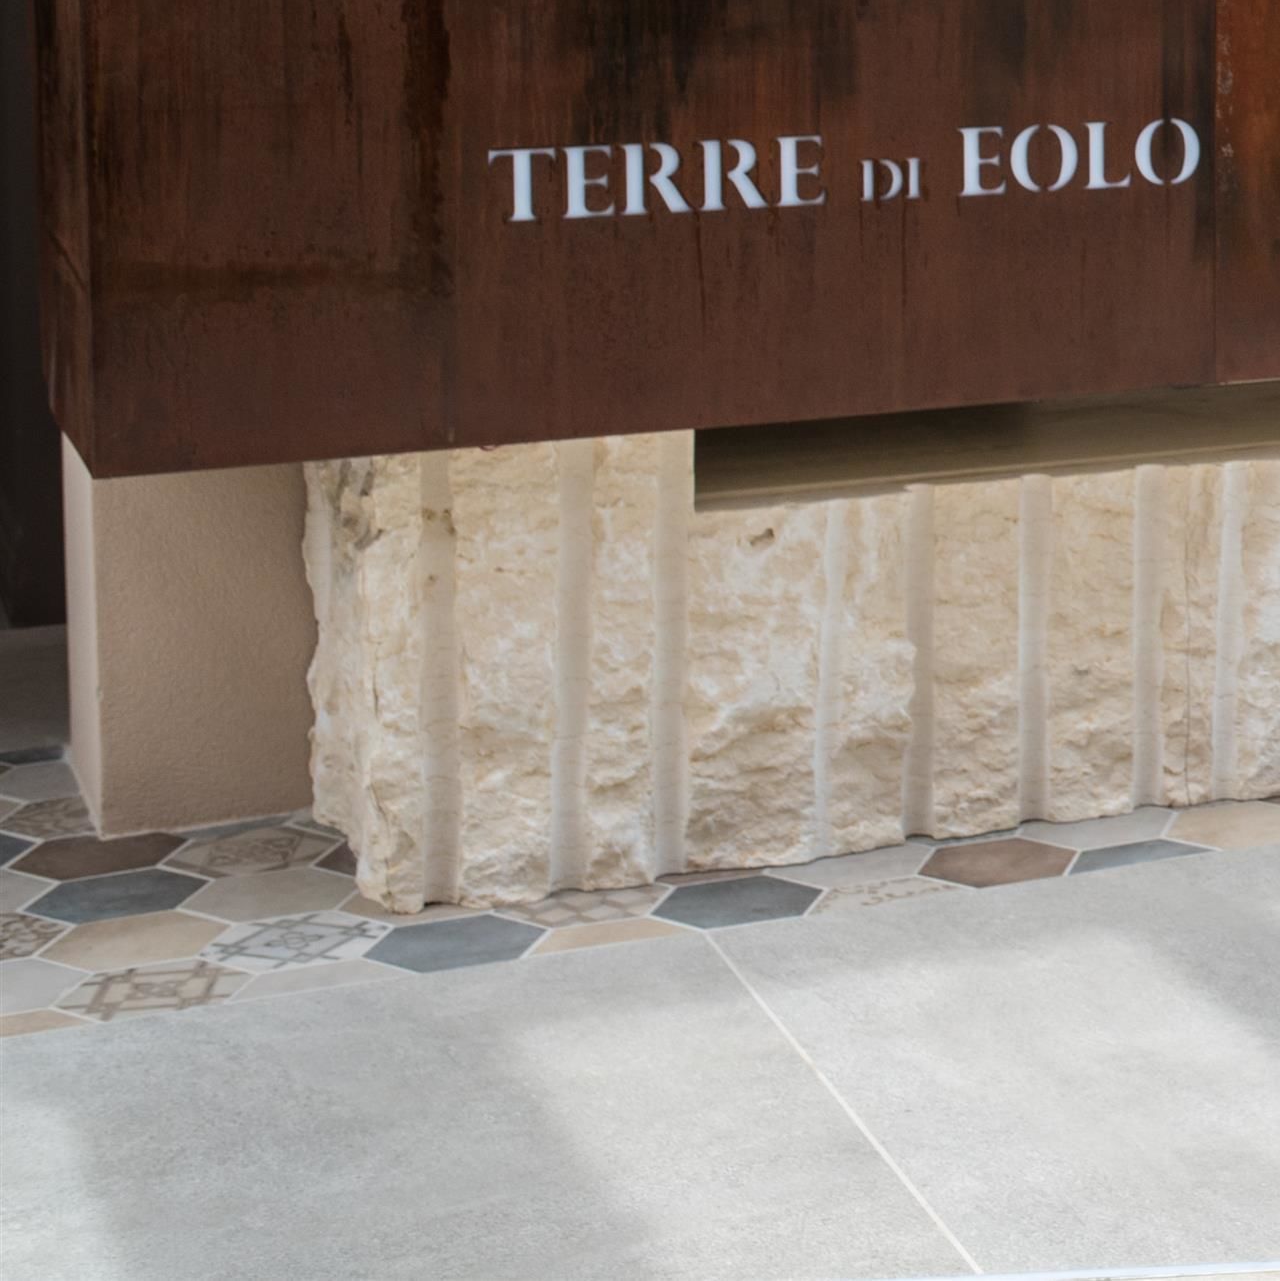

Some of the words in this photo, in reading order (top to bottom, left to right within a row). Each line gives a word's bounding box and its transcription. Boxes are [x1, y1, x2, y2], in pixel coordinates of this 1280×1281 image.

[488, 134, 827, 223] TERRE
[859, 157, 923, 202] DI
[957, 117, 1203, 198] EOLO
